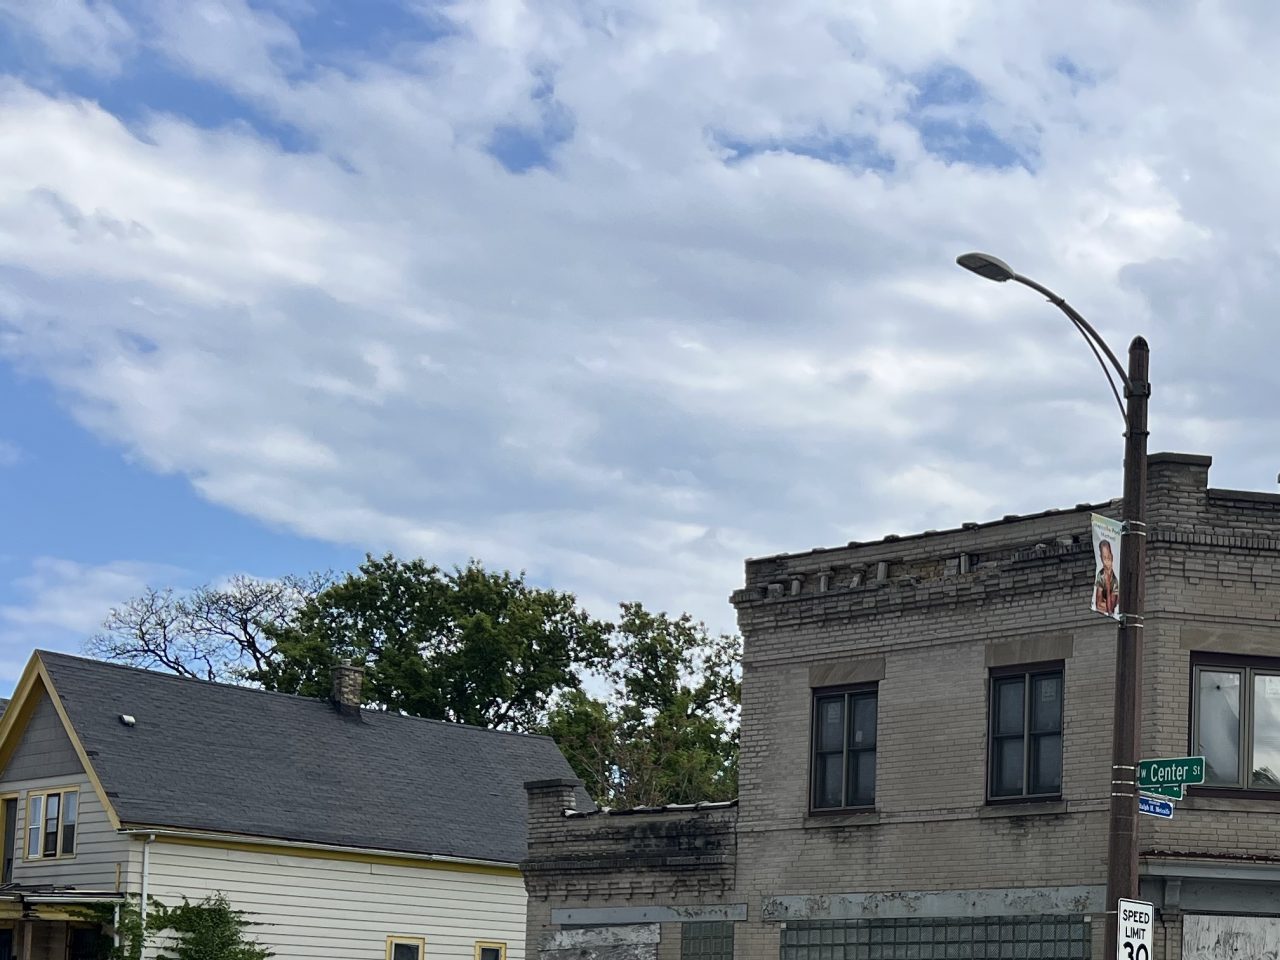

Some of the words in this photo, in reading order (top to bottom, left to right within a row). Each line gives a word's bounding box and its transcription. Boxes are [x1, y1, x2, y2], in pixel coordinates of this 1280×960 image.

[1141, 768, 1147, 778] W
[1150, 763, 1188, 782] Center
[1192, 765, 1201, 775] St
[1122, 909, 1150, 924] SPEED
[1125, 926, 1146, 940] LIMIT
